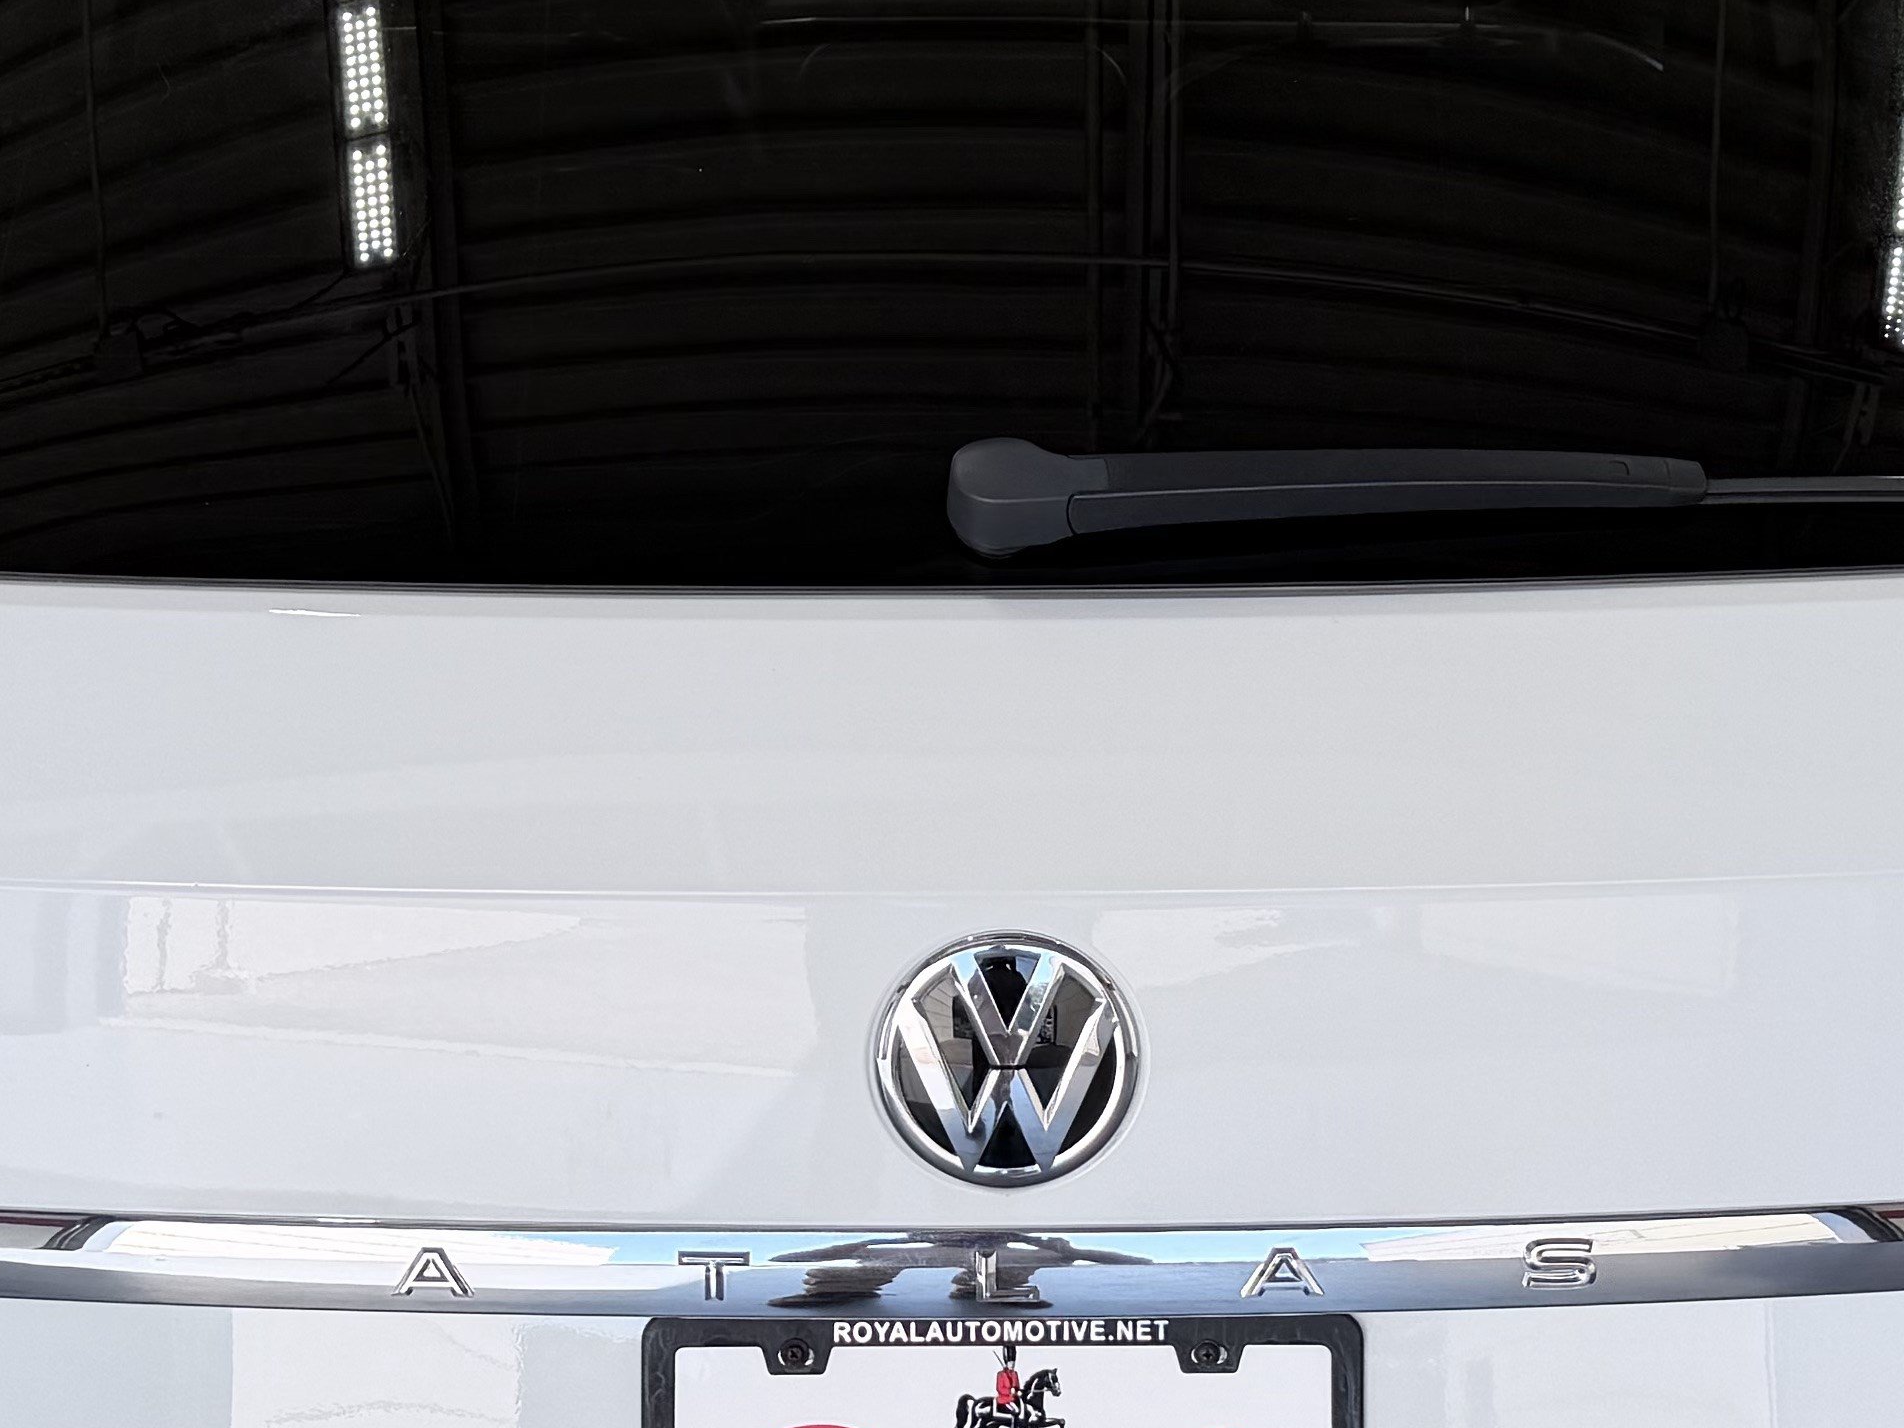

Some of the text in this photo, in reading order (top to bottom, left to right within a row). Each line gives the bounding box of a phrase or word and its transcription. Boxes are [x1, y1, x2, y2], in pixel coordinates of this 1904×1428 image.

[882, 938, 1130, 1182] VW
[392, 1236, 1599, 1304] ATLAS
[832, 1318, 1170, 1345] ROYALAUTOMOTIVE.NET
